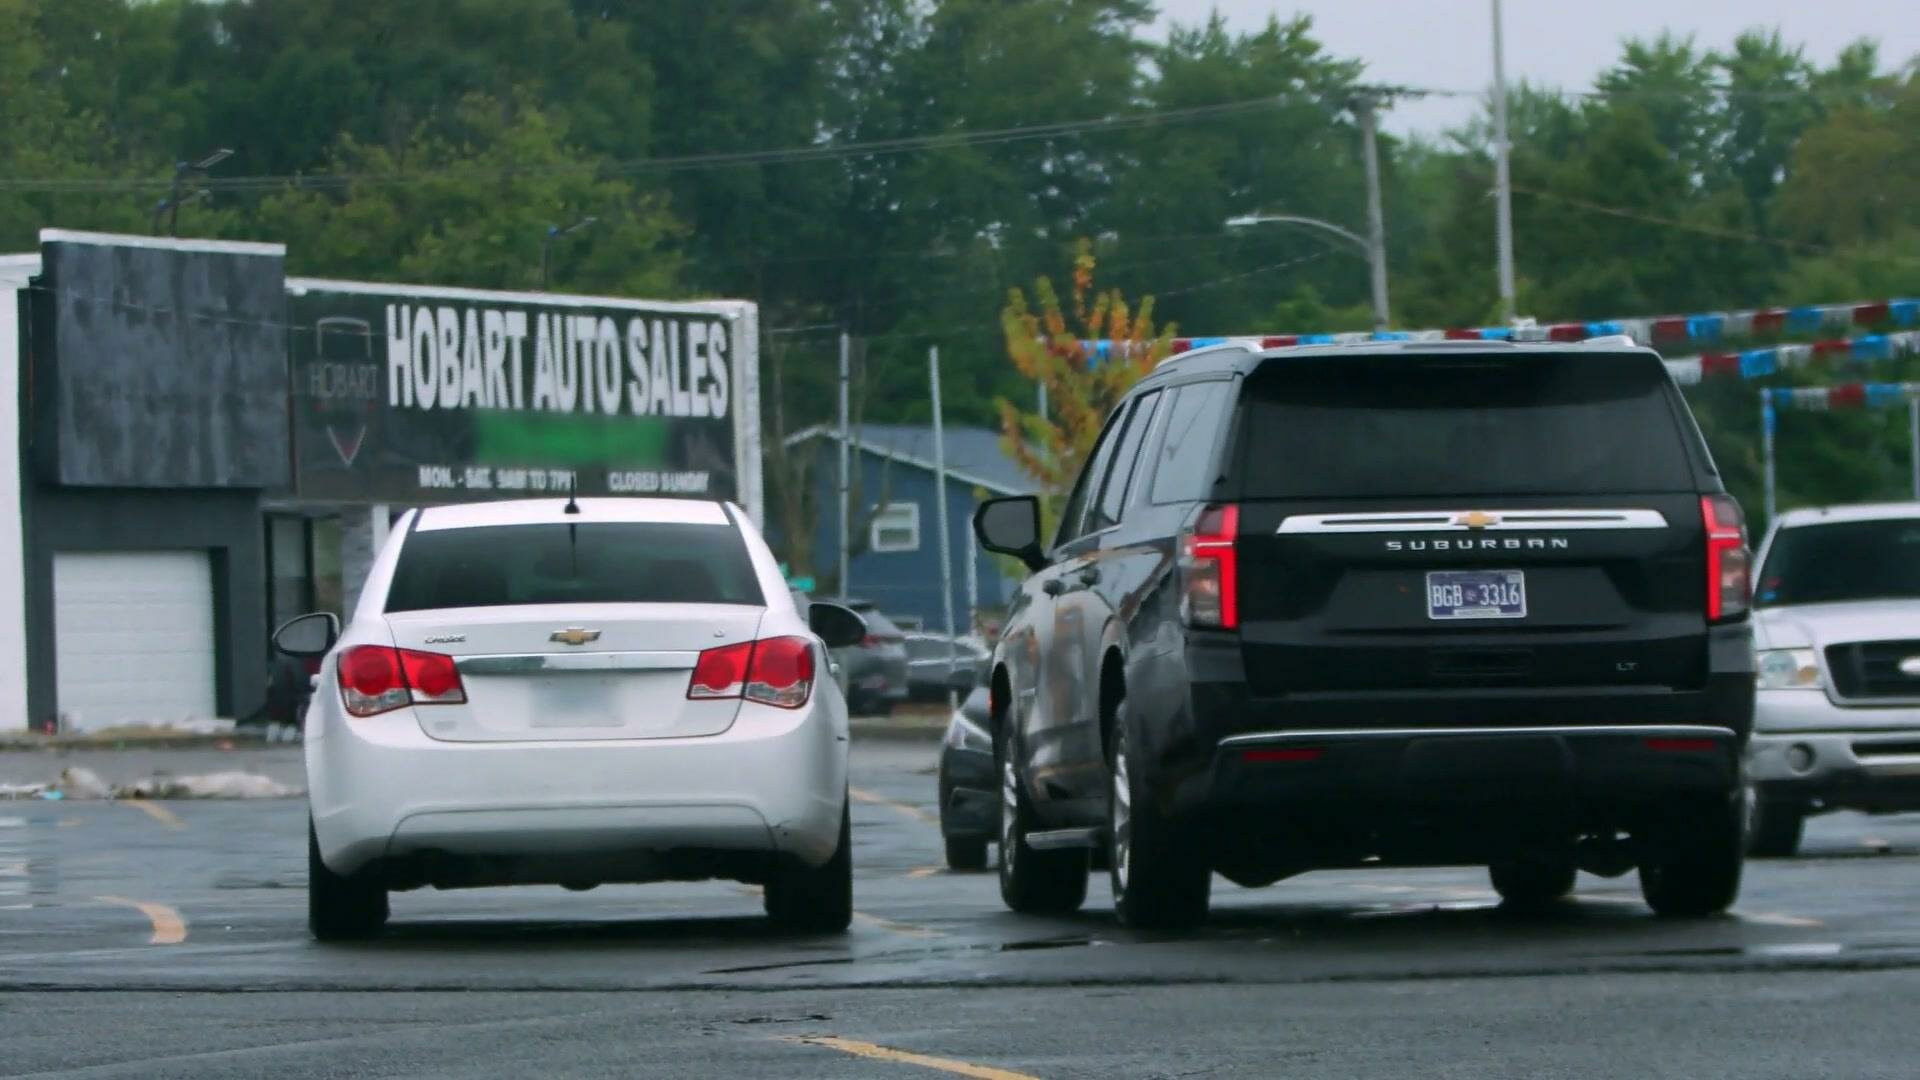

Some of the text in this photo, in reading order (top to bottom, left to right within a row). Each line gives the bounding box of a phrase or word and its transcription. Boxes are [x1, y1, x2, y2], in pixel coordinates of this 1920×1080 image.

[386, 303, 728, 419] HOBART AUTO SALES
[311, 362, 377, 399] HOBART
[1387, 538, 1569, 550] SUBURBAN
[1432, 583, 1520, 608] BGB 3316
[1616, 662, 1638, 671] LT
